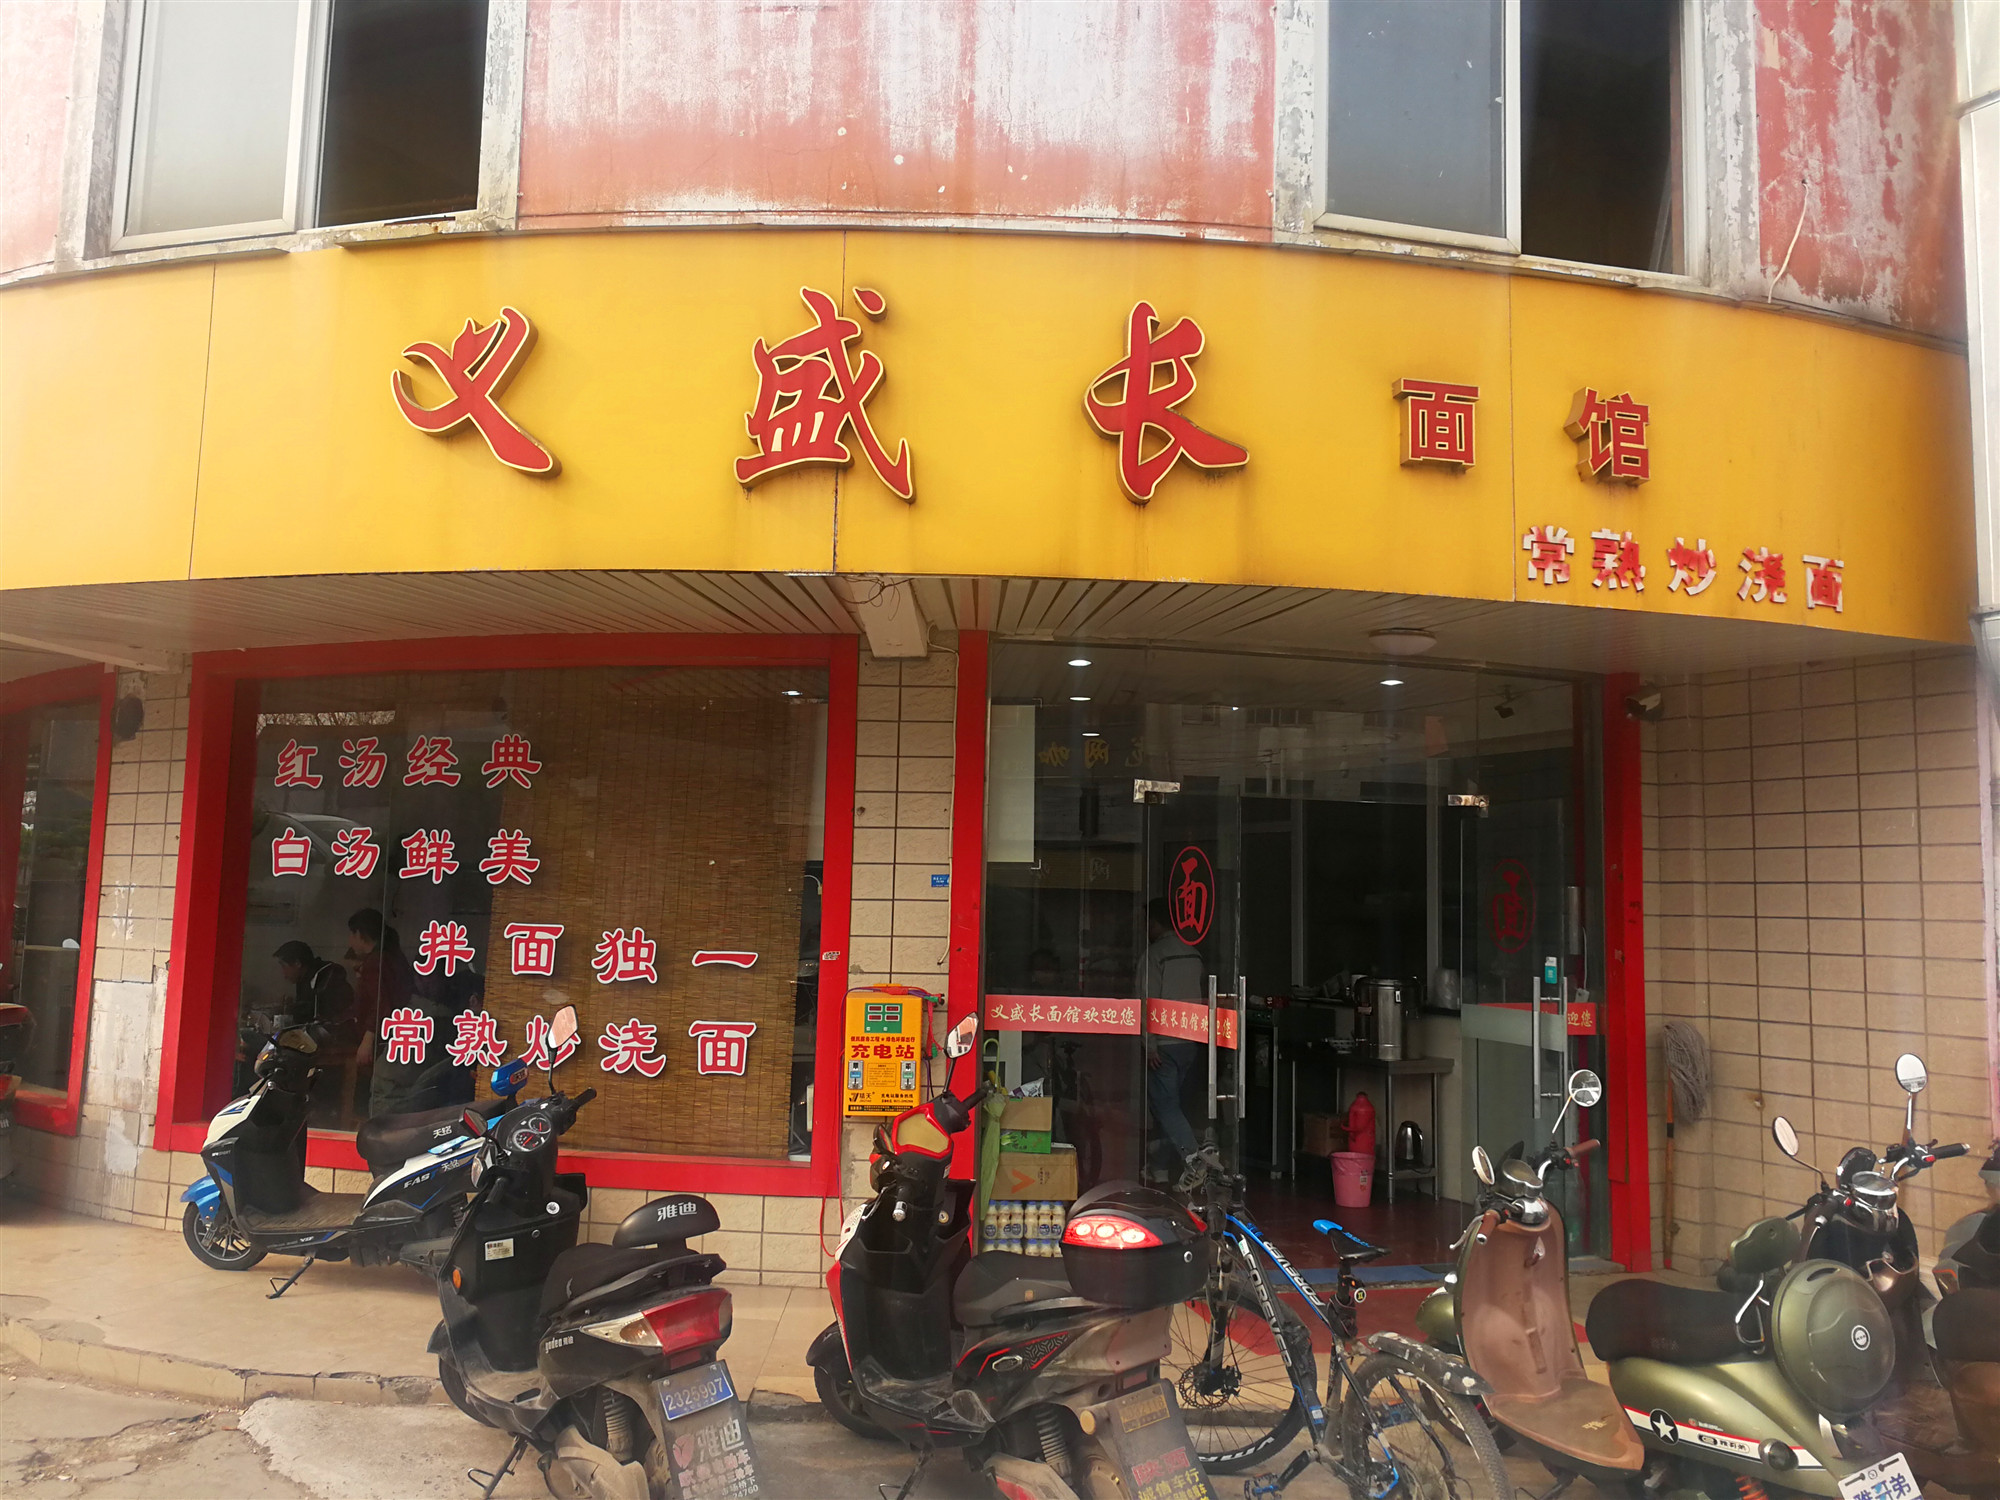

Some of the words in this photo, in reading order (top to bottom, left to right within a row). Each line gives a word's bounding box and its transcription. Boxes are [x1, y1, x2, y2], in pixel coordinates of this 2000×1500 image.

[1523, 525, 1845, 614] 常熟炒浇面
[275, 733, 543, 789] 红汤经典
[271, 827, 541, 885] 白汤鲜美
[1175, 857, 1208, 934] 面
[414, 920, 759, 984] 拌面独一
[381, 1006, 757, 1079] 常熟炒浇面
[990, 1003, 1137, 1027] 义盛长面馆欢迎您
[851, 1044, 915, 1059] 充电站
[657, 1202, 698, 1222] 雅迪
[1263, 1241, 1326, 1306] FOREVER
[1245, 1254, 1292, 1368] FOREVER
[664, 1377, 725, 1411] 2325907
[696, 1417, 745, 1463] 雅迪
